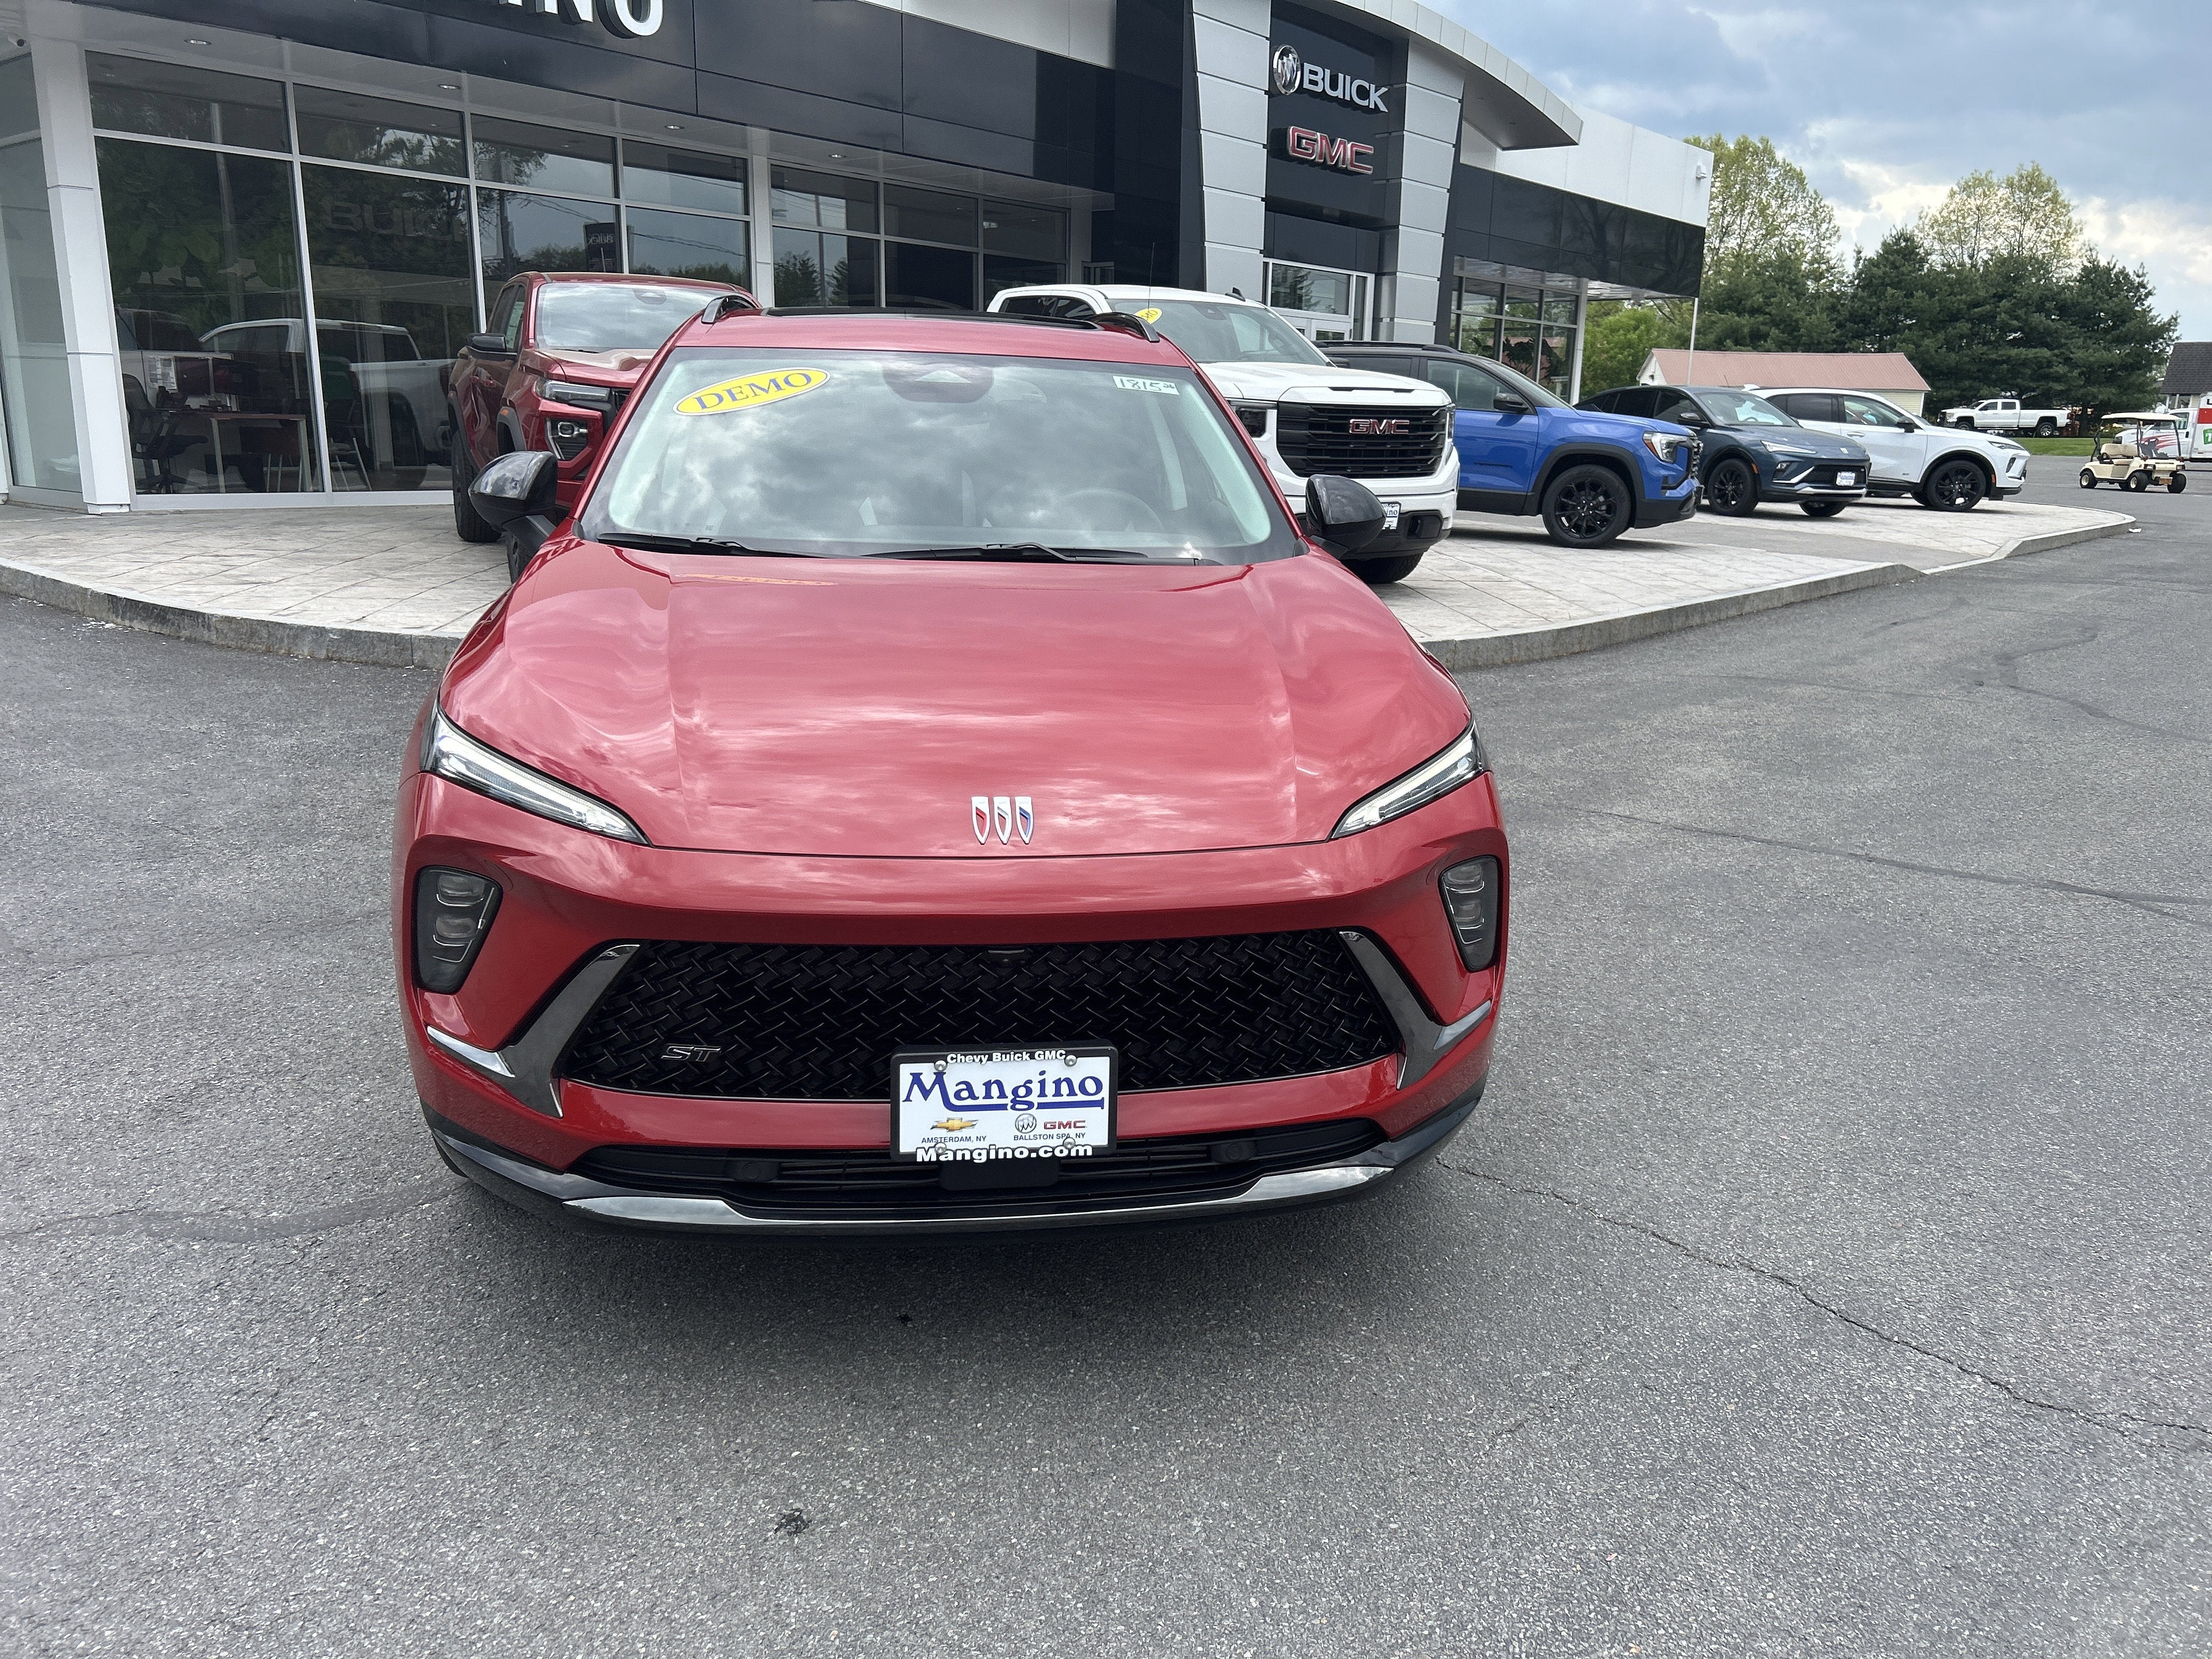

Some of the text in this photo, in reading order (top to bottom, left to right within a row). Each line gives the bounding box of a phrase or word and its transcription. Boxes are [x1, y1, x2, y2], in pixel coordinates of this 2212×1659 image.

[1303, 62, 1389, 112] BUICK
[1287, 126, 1374, 174] GMC
[692, 373, 812, 410] DEMO
[1120, 378, 1162, 391] 1815
[1350, 419, 1410, 435] GMC
[661, 1046, 721, 1062] ST
[947, 1049, 1066, 1065] Chevy Buick GMC
[902, 1070, 1104, 1112] Mangino
[1043, 1120, 1086, 1130] GMC
[921, 1136, 974, 1144] AMSTERDAM,
[916, 1144, 1092, 1163] Mangino.com
